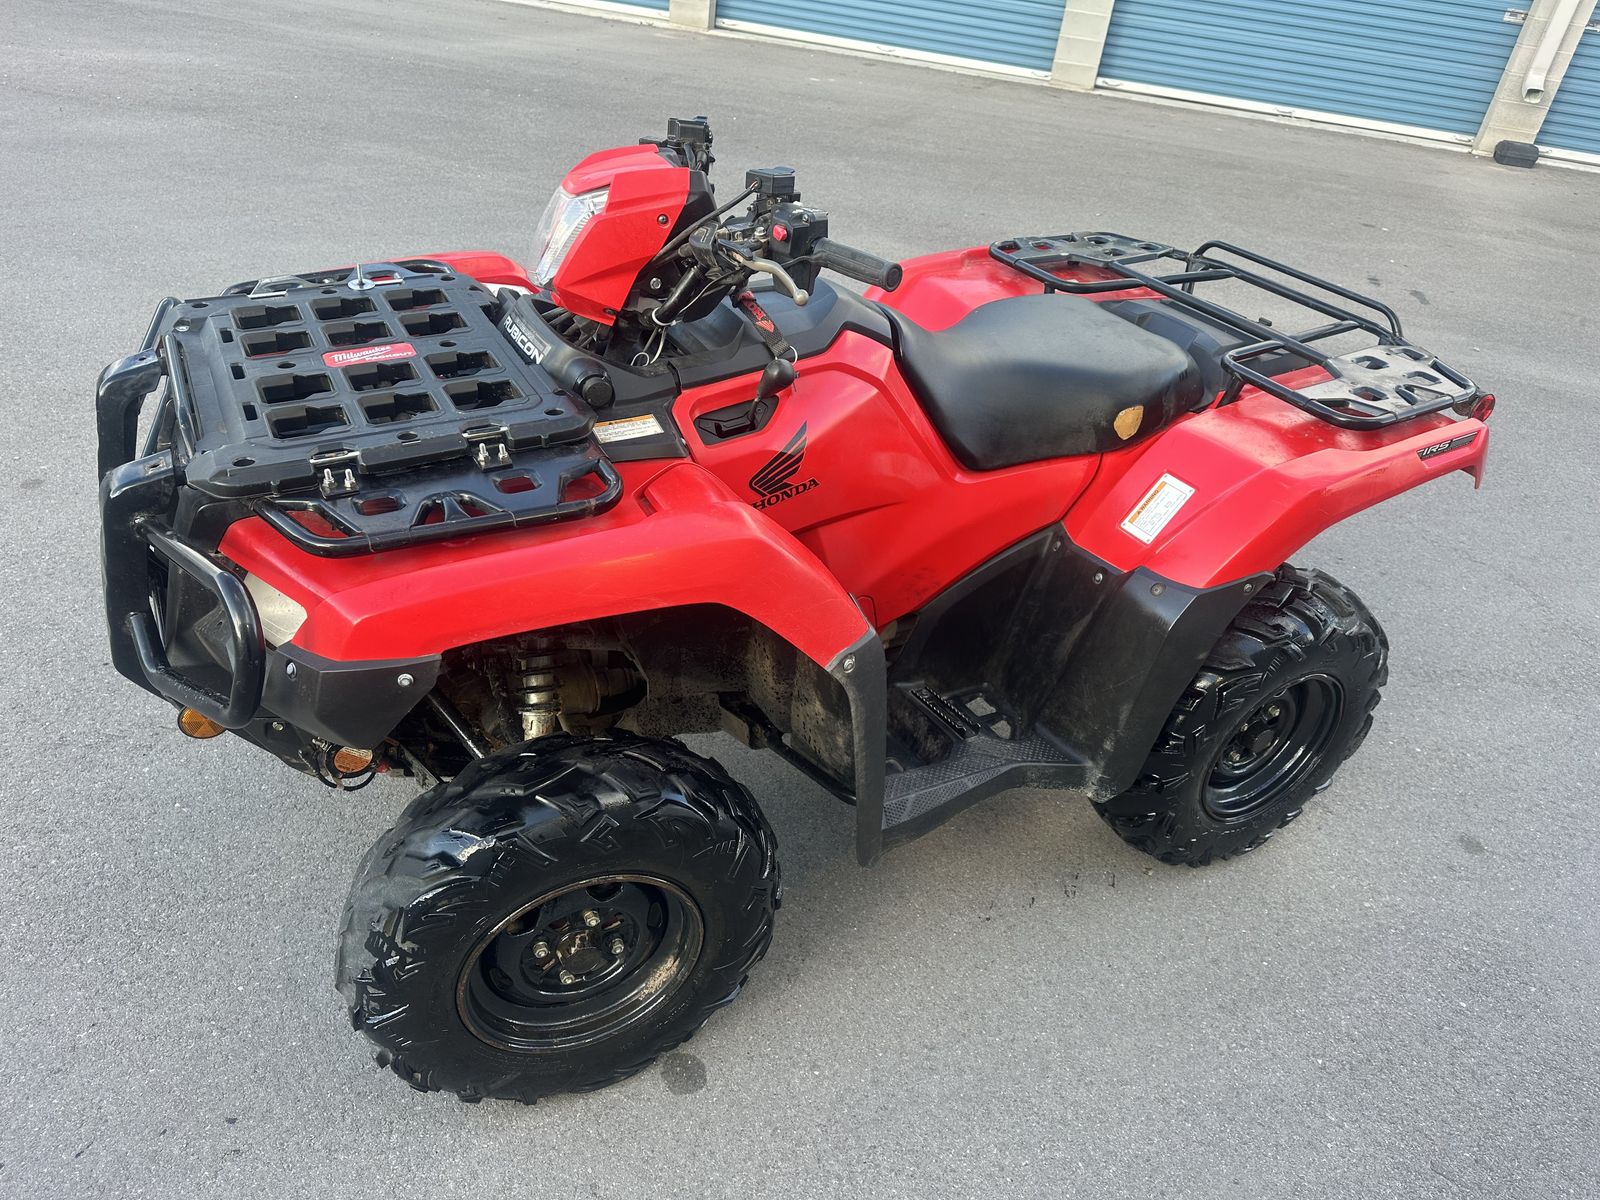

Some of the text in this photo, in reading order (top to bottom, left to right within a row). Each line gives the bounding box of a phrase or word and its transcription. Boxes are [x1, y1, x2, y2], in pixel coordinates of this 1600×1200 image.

[503, 315, 544, 365] RUBICON
[1422, 440, 1451, 456] IRS
[752, 477, 820, 510] HONDA
